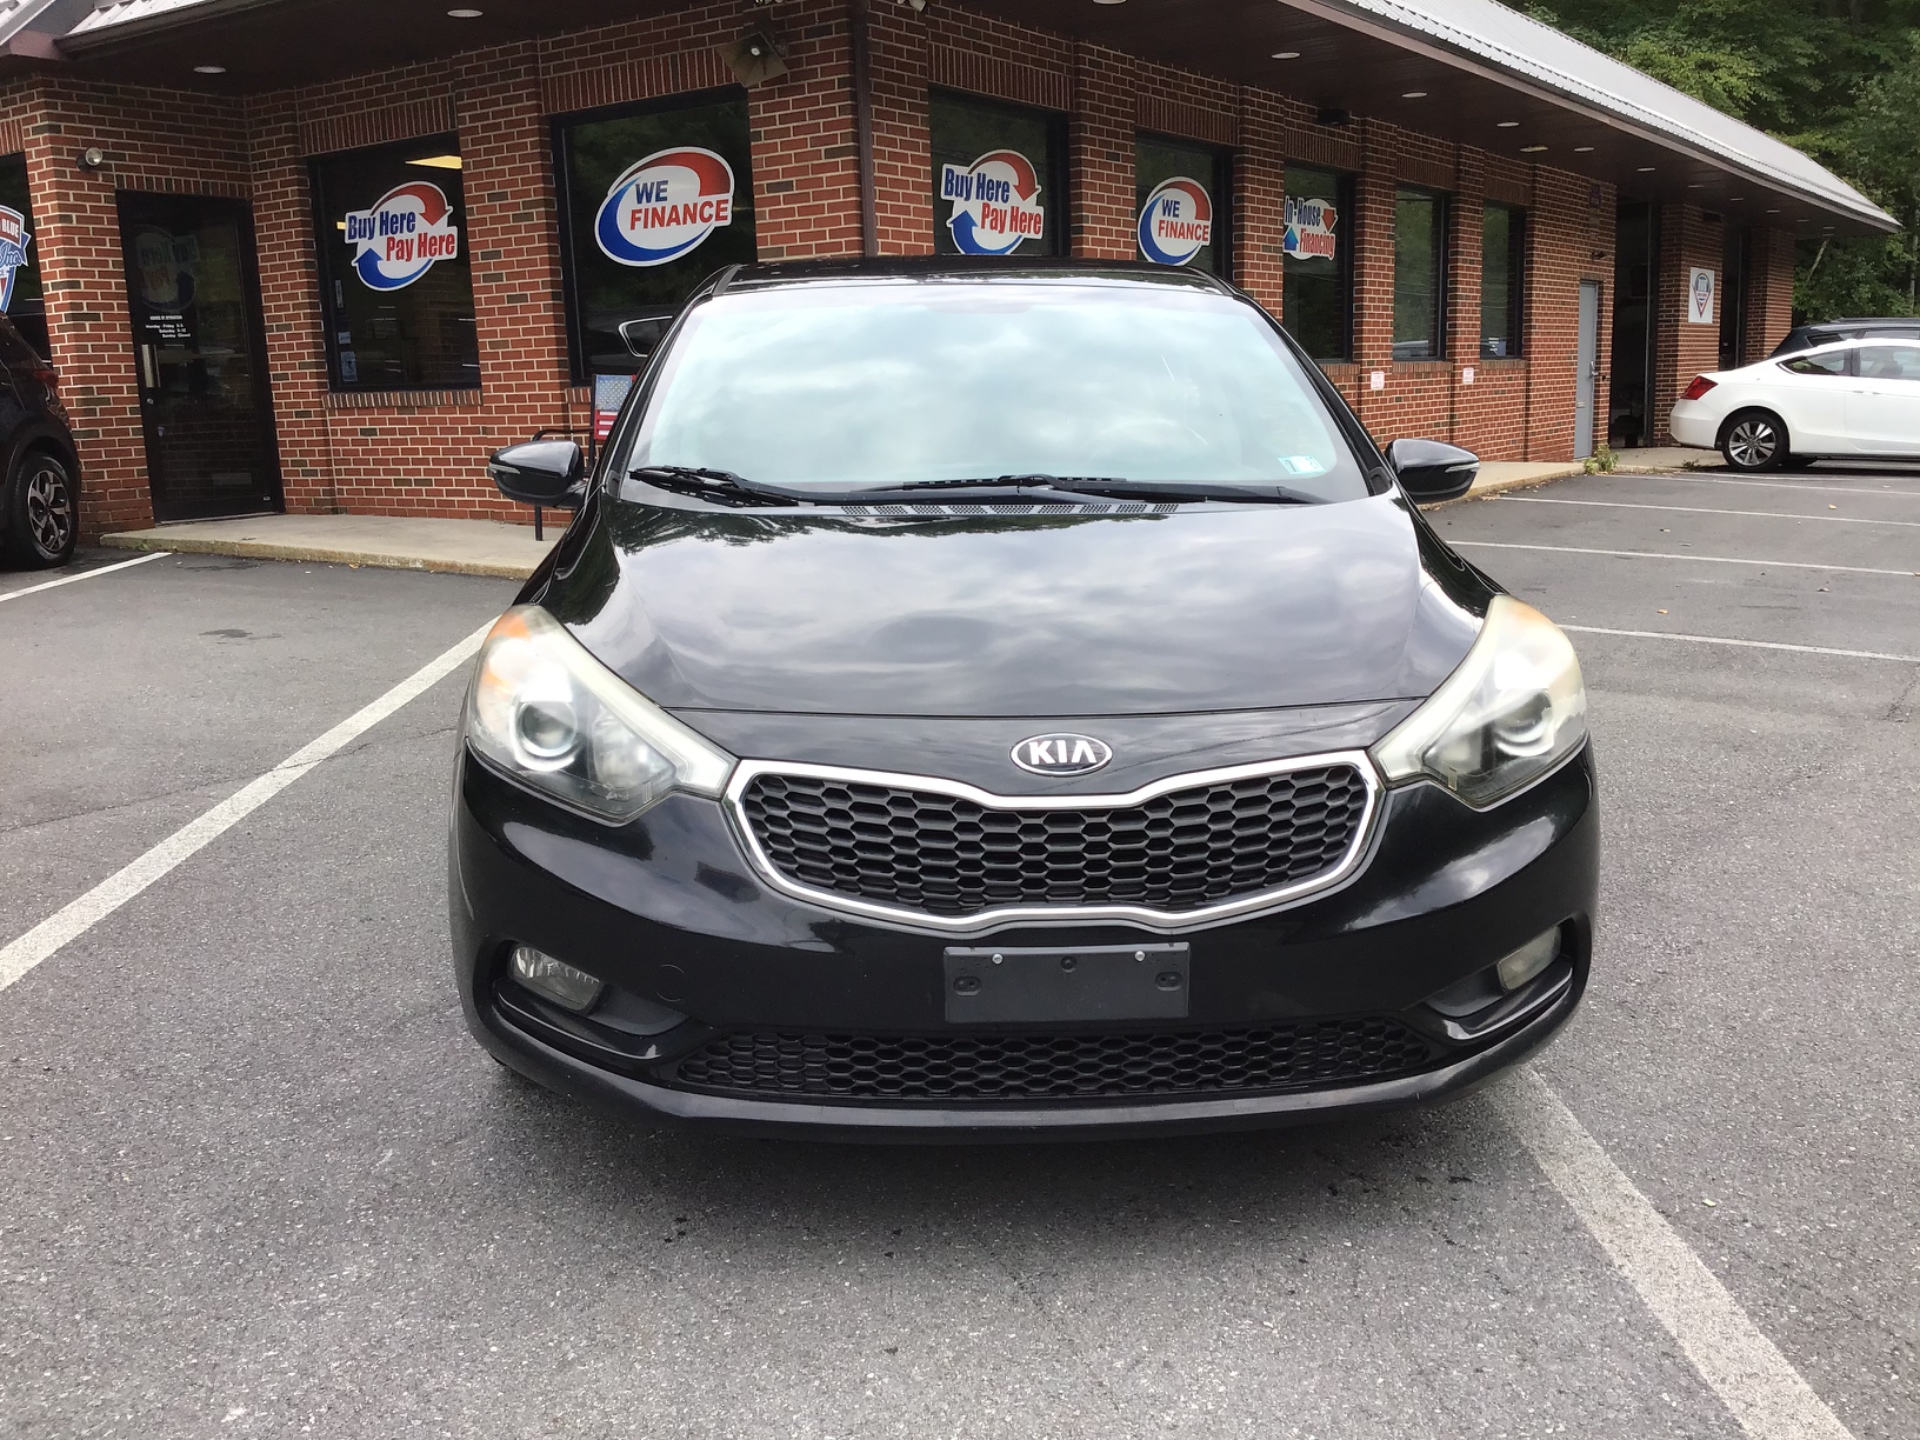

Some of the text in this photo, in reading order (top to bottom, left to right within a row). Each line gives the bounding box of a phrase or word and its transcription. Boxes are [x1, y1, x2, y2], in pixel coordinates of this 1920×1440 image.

[635, 180, 668, 205] WE
[944, 168, 1010, 204] Buy Here
[630, 199, 729, 230] FINANCE
[981, 202, 1041, 235] Pay Here
[1162, 199, 1180, 218] WE
[1285, 197, 1321, 227] In-House
[1, 218, 19, 238] BLUE
[348, 211, 416, 241] Buy Here
[1158, 219, 1209, 242] FINANCE
[386, 232, 455, 262] Pay Here
[1028, 740, 1097, 765] KIA
